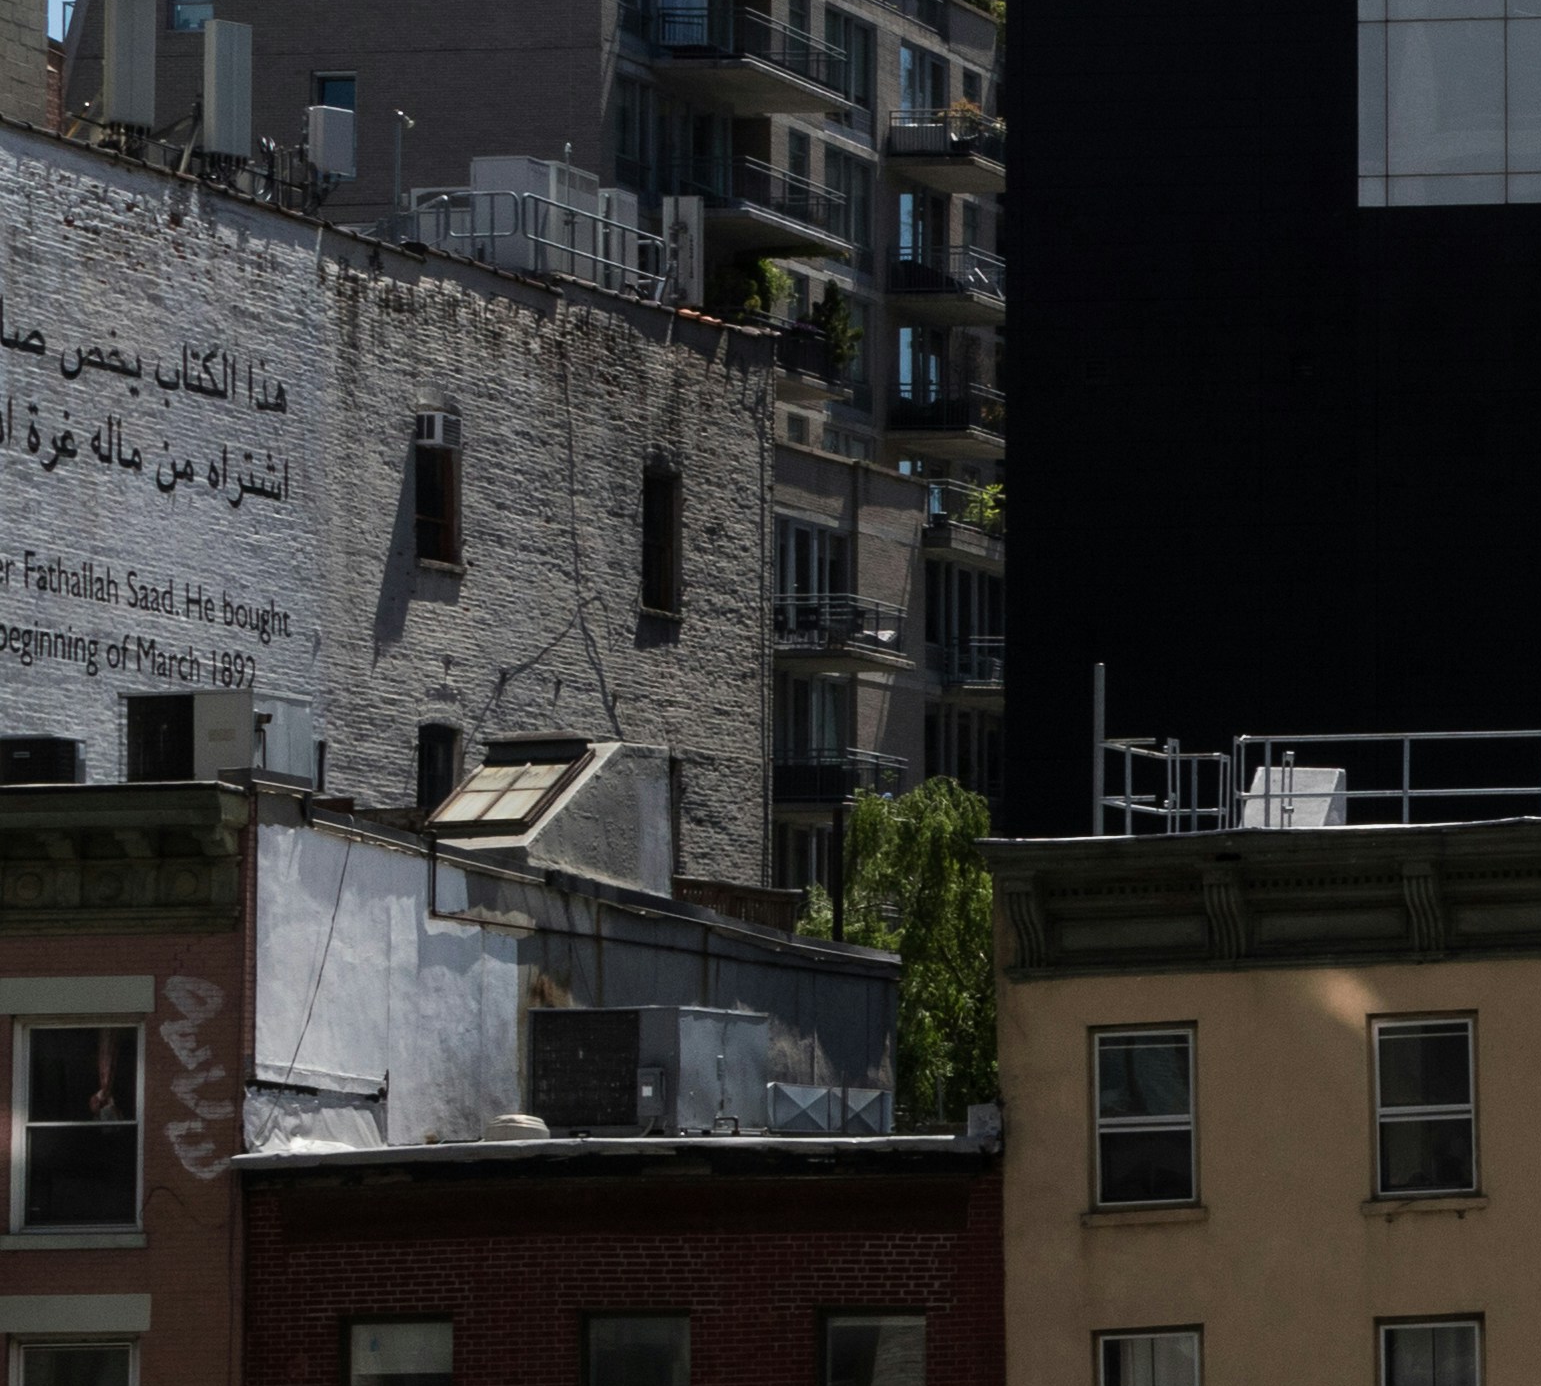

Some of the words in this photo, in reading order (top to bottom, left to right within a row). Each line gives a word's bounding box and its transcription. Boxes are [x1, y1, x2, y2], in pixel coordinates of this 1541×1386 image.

[23, 549, 119, 606] Fathallah
[184, 582, 216, 624] He
[222, 590, 292, 646] bought
[106, 633, 131, 671] of
[136, 635, 200, 684] March
